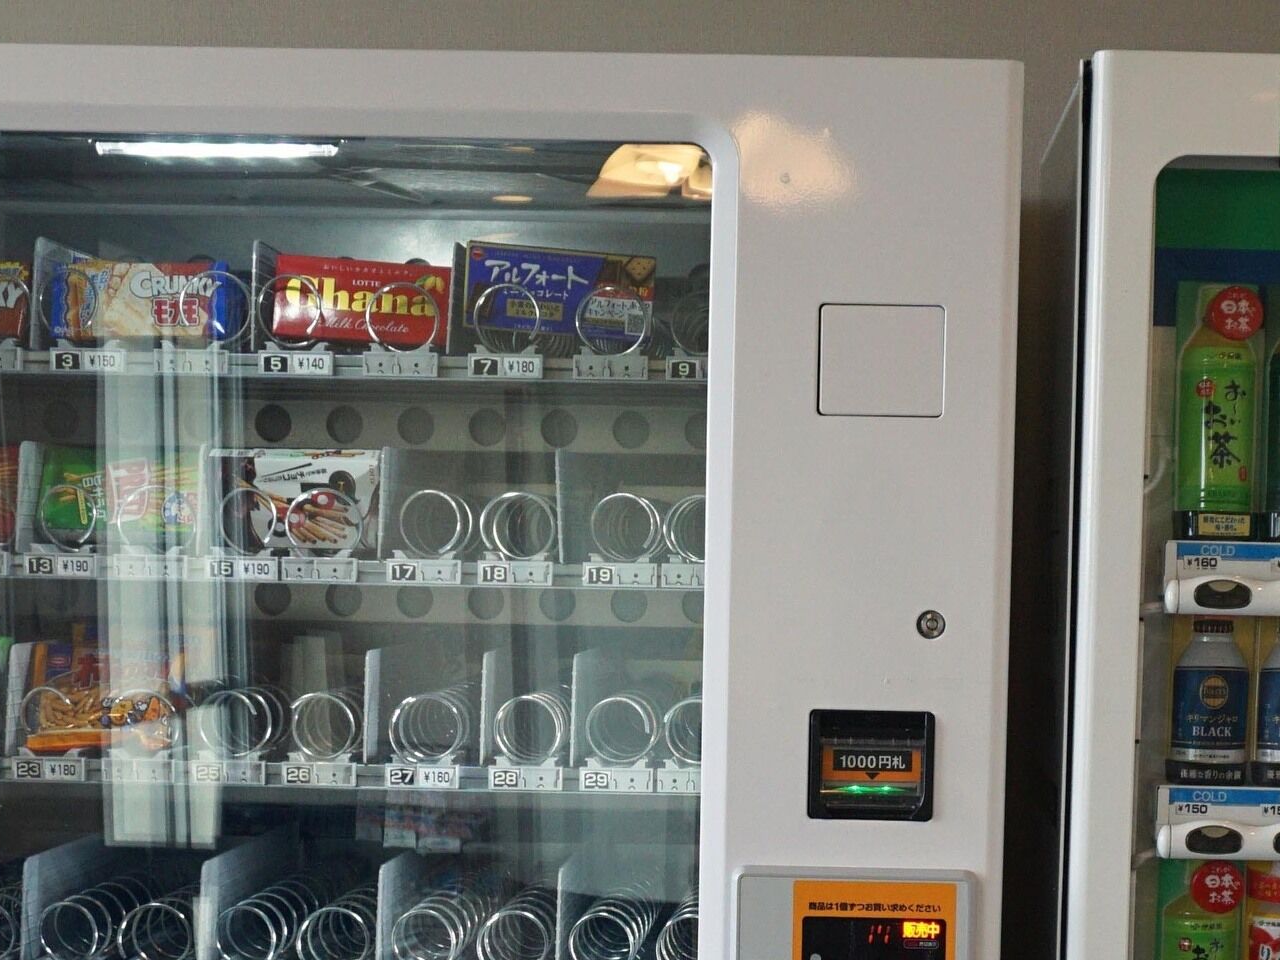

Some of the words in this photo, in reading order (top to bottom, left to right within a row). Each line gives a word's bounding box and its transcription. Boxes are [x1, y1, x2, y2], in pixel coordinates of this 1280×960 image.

[484, 259, 589, 289] アルフォート
[129, 271, 222, 298] CRUNKY
[352, 279, 382, 287] LOTTE
[284, 275, 437, 317] Ghana
[89, 355, 116, 367] ¥150
[298, 359, 325, 371] ¥140
[508, 361, 535, 373] ¥180
[1201, 545, 1236, 557] COLD
[30, 558, 52, 571] 13
[62, 561, 89, 572] ¥190
[243, 563, 270, 575] ¥190
[394, 565, 414, 580] 17
[486, 566, 506, 580] 18
[590, 568, 611, 583] 19
[1192, 726, 1232, 737] BLACK
[839, 755, 906, 769] 1000円札
[17, 763, 41, 777] 23
[391, 769, 413, 783] 27
[494, 771, 518, 785] 28
[585, 774, 608, 787] 29
[1192, 790, 1227, 802] COLD
[1177, 803, 1208, 814] ¥150
[1209, 890, 1235, 904] お茶
[809, 902, 942, 913] 商品は1個ずつお買い求めください
[903, 921, 941, 939] 販売中
